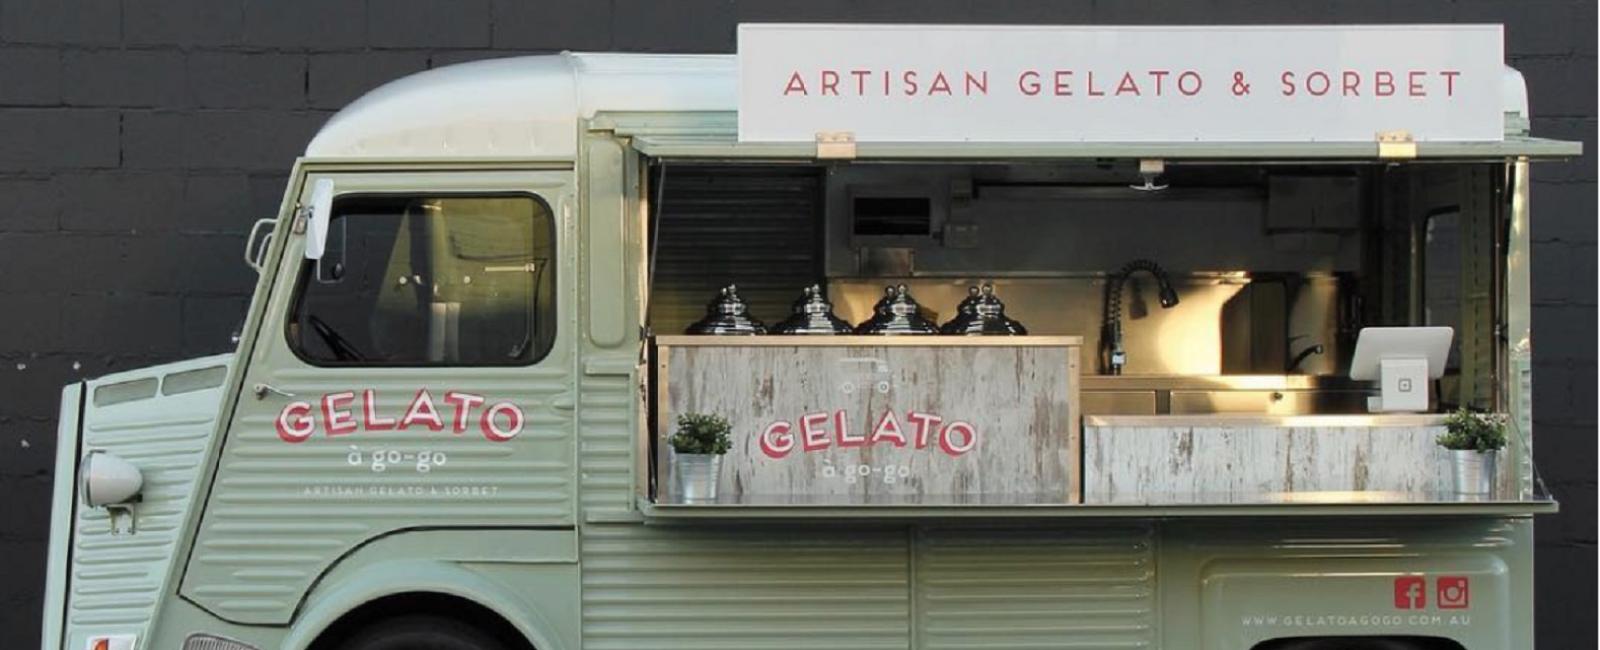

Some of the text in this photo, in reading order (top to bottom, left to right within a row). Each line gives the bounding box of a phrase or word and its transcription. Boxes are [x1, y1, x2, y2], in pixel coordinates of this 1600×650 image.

[783, 69, 1464, 98] ARTISAN GELATO & SORBET
[275, 388, 525, 443] GELATO
[759, 406, 977, 459] GELATO
[347, 445, 447, 472] à go-go
[844, 464, 910, 484] go-go
[303, 485, 364, 496] ARTISAN
[369, 485, 423, 496] GELATO
[445, 485, 499, 496] SORBET
